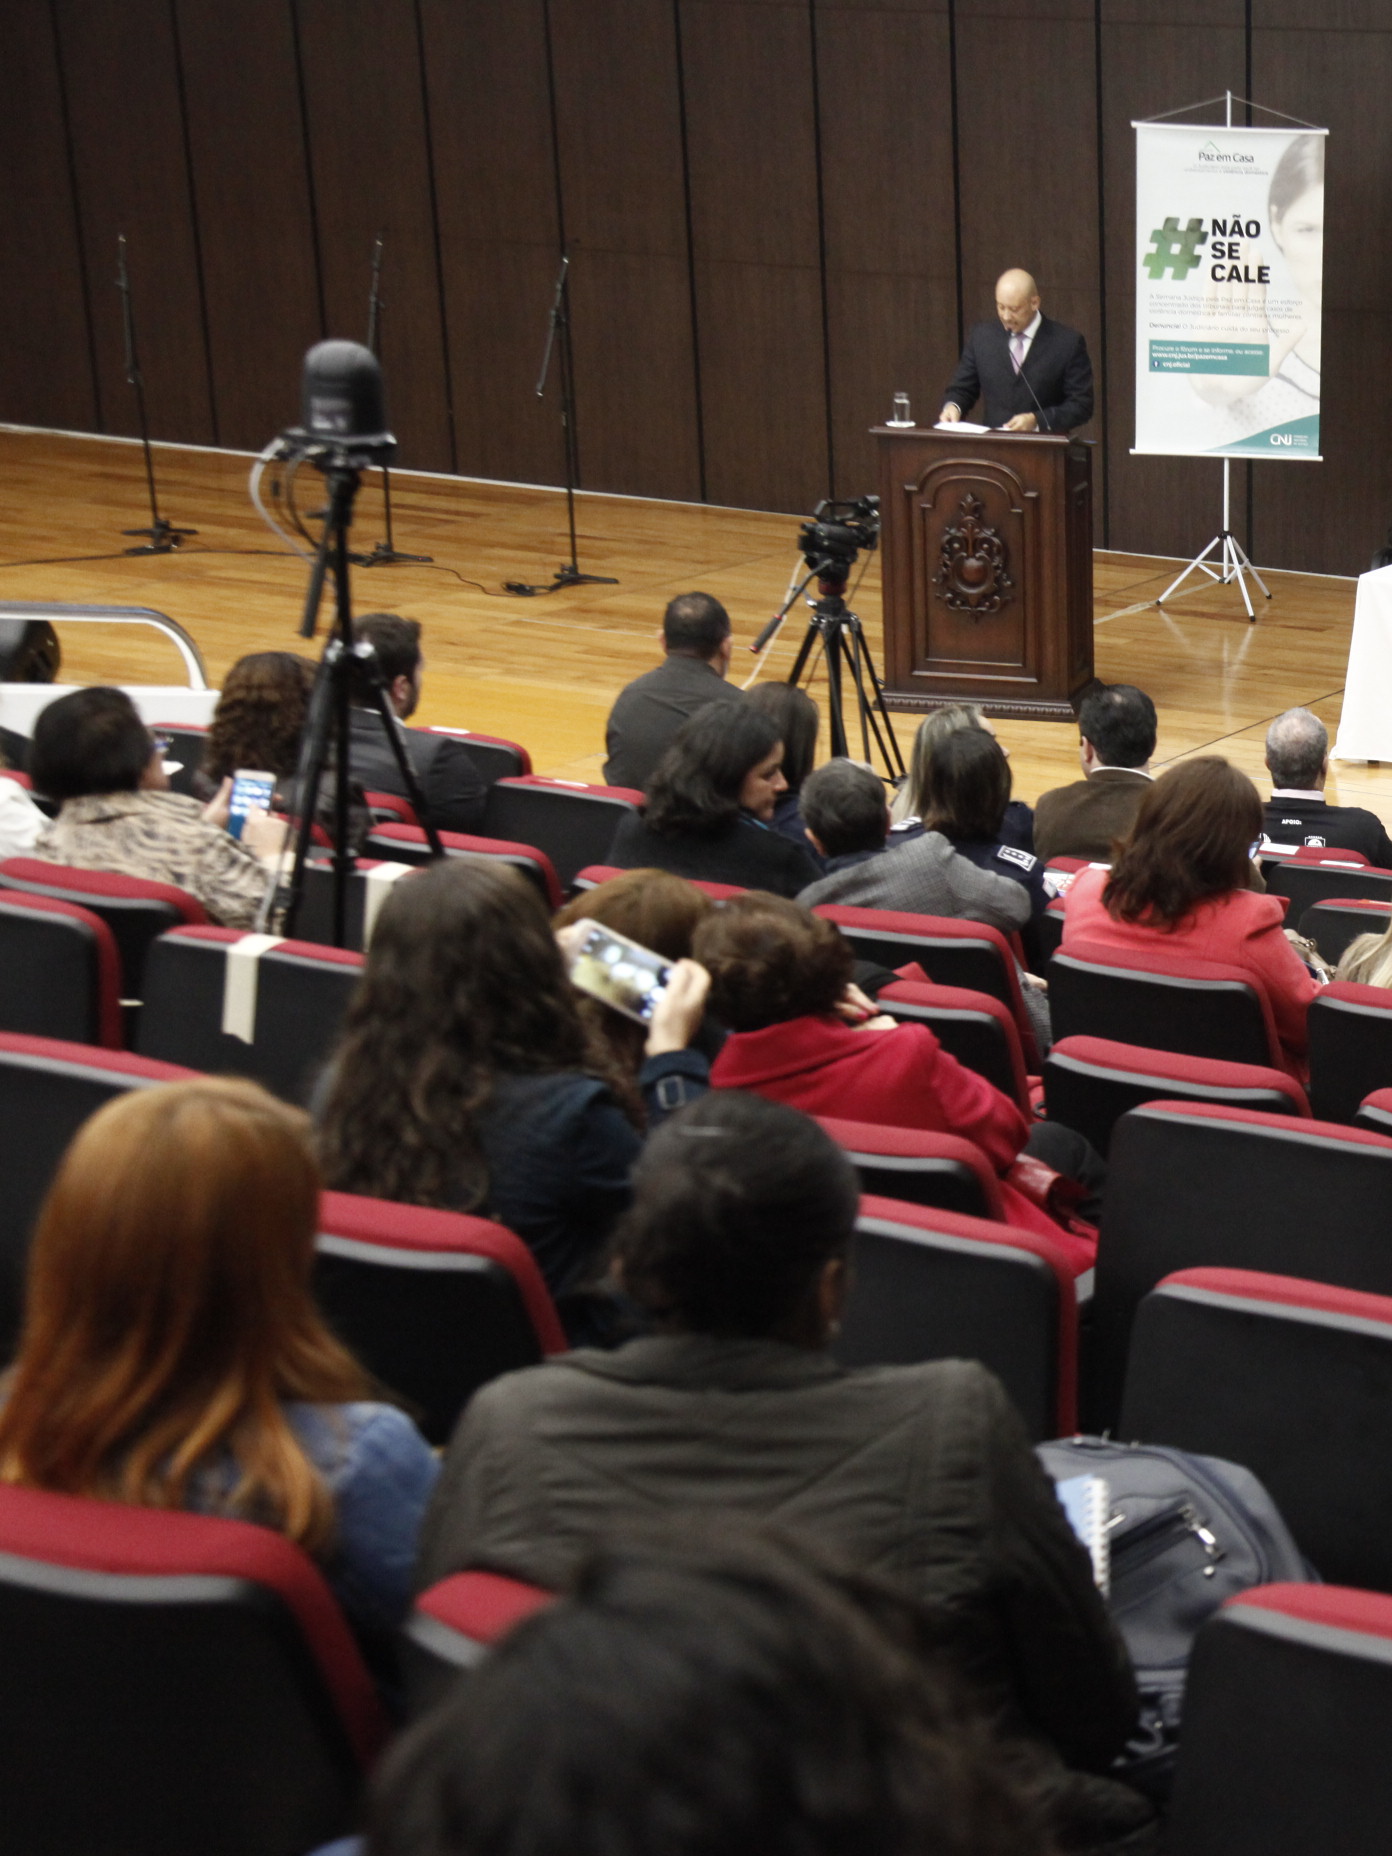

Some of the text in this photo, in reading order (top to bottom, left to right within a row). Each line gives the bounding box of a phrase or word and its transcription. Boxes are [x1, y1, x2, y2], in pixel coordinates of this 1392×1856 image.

[1198, 152, 1254, 163] Paz em Casa
[1211, 214, 1261, 238] NÃO
[1211, 242, 1240, 260] SE
[1211, 263, 1270, 284] CALE
[1270, 433, 1293, 446] CNJ
